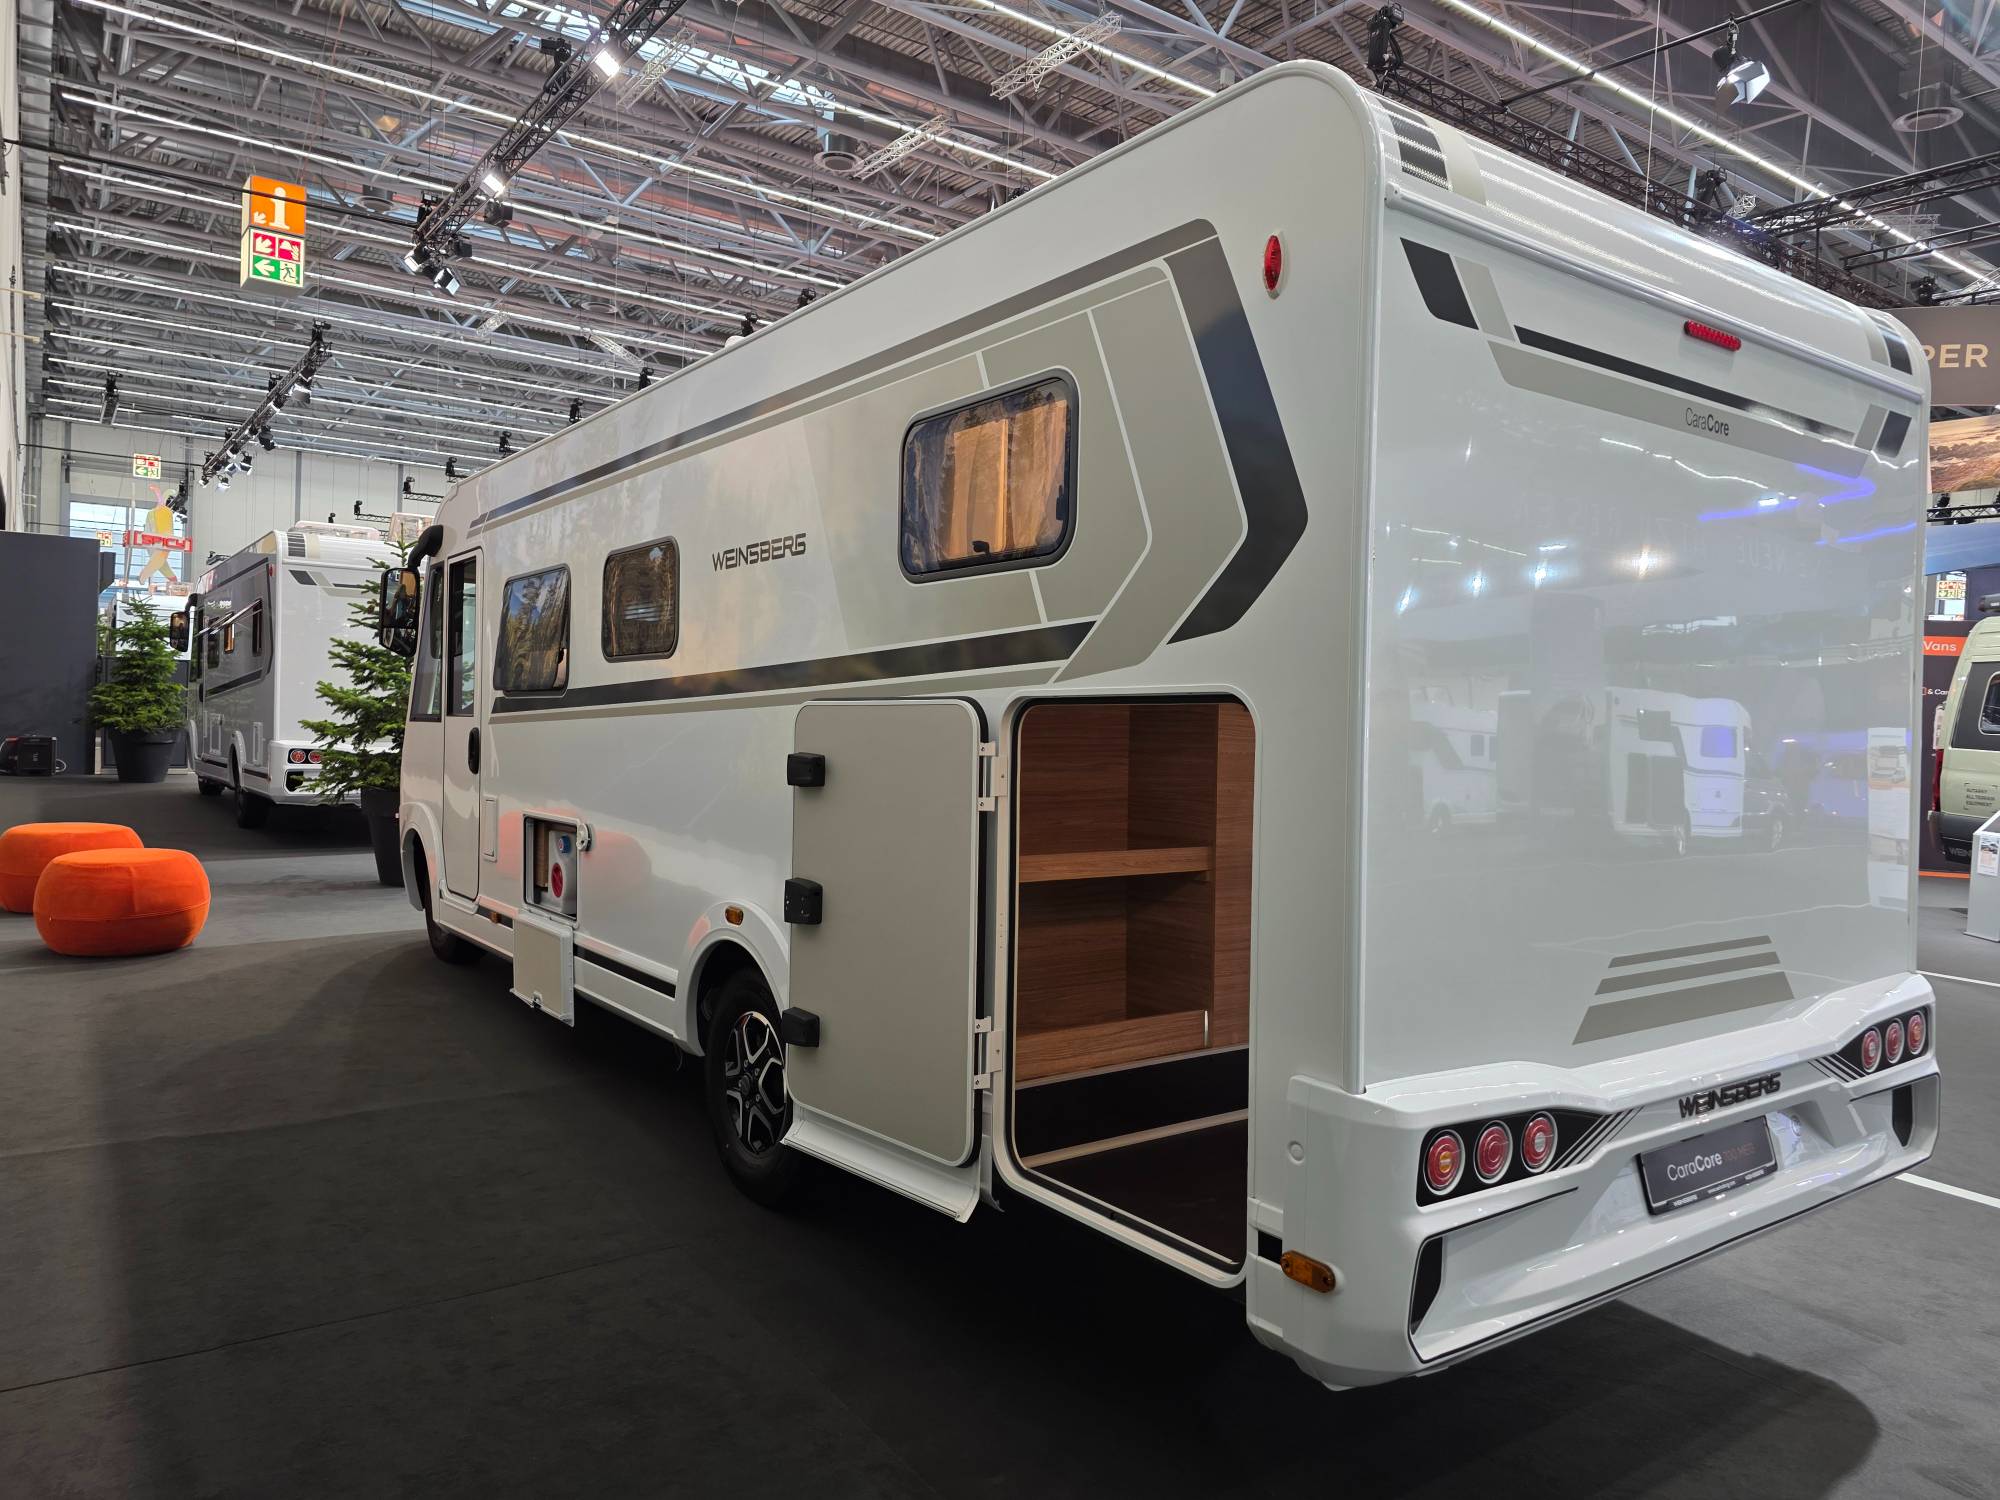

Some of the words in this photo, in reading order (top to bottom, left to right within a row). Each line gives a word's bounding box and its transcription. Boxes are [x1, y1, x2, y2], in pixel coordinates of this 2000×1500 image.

[1685, 407, 1730, 437] CaraCore
[711, 532, 807, 572] WEINSBERG
[1923, 640, 1957, 652] Vans
[1678, 1071, 1781, 1119] WEINSBERG
[1666, 1152, 1723, 1181] CaraCore
